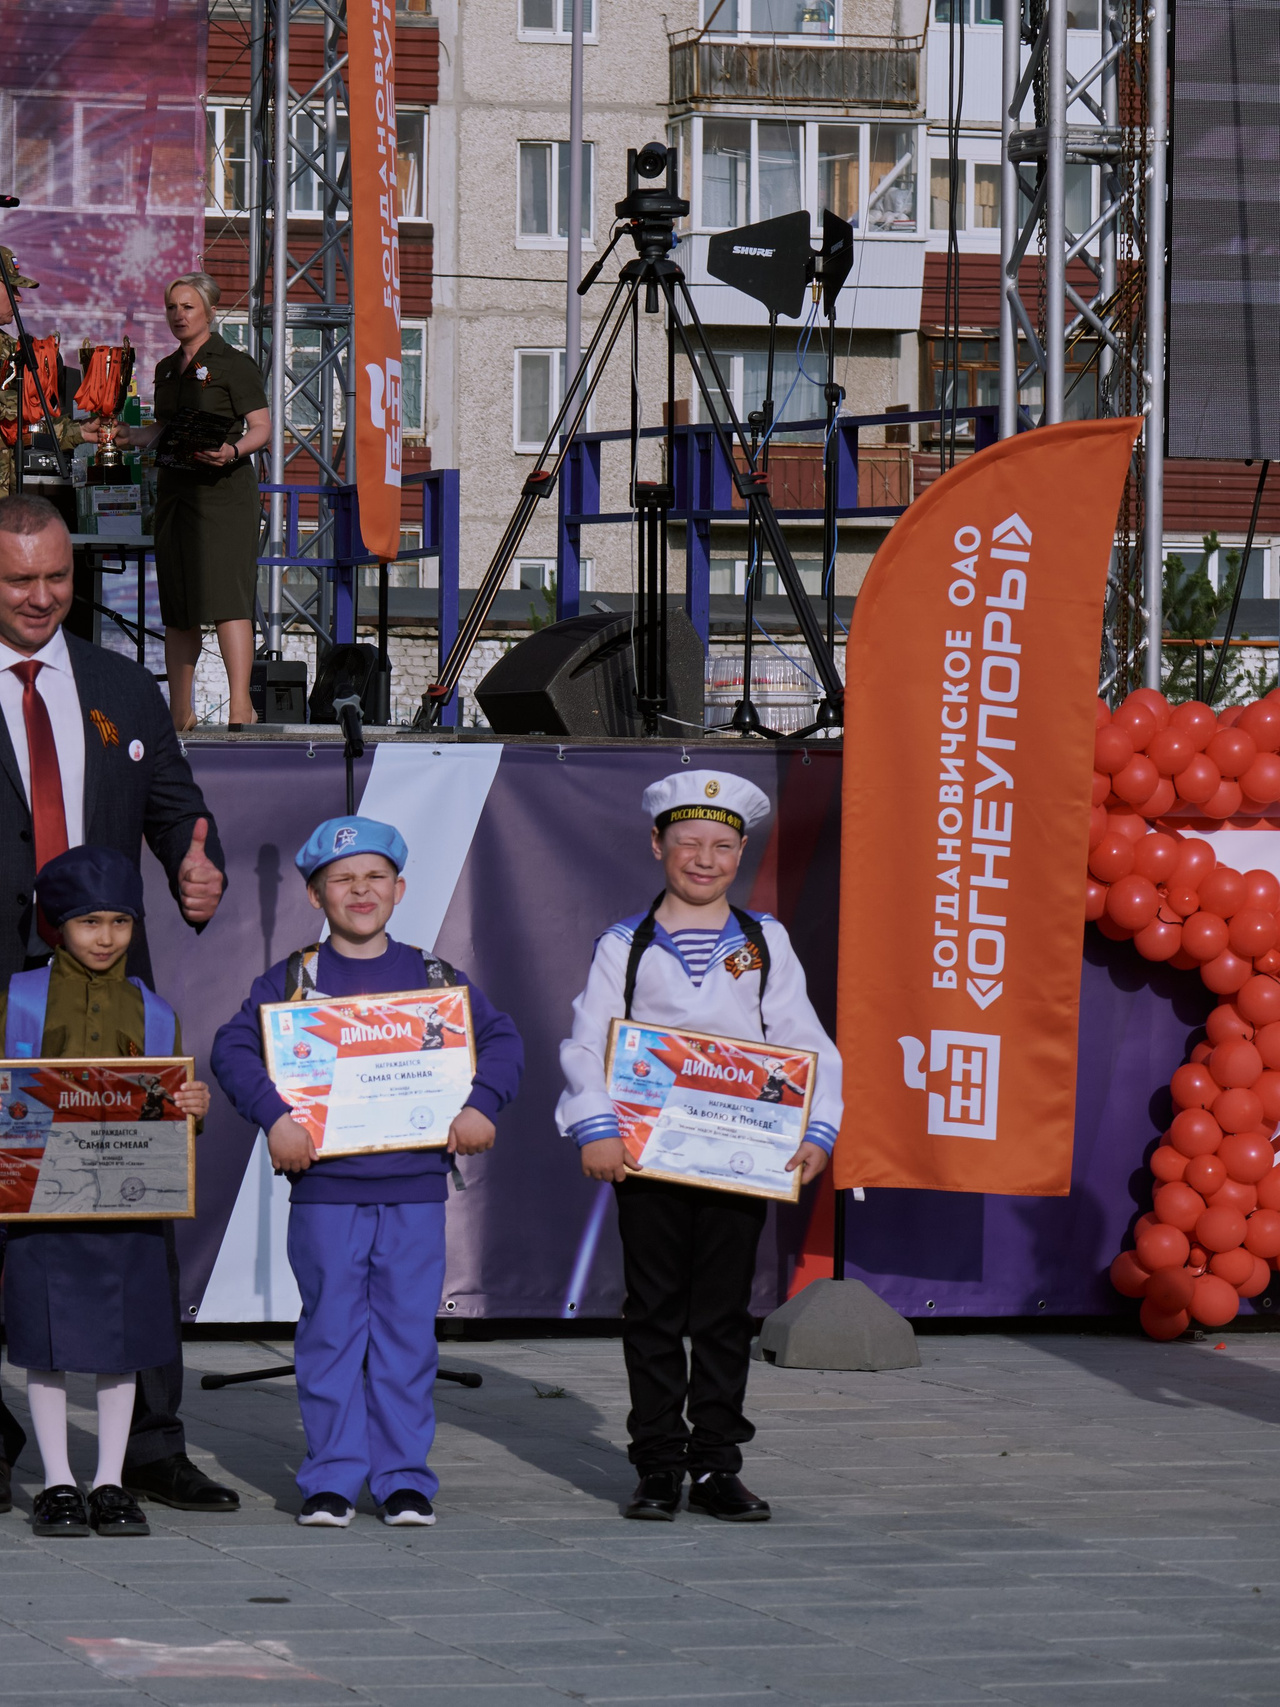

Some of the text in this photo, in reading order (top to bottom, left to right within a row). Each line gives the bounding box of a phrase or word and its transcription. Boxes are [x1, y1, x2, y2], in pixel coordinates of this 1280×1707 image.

[732, 245, 775, 258] SHURE
[933, 525, 982, 990] БОГДАНОВИЧСКОЕ ОАО
[670, 806, 727, 823] РОССИЙСКИЙ
[340, 1021, 412, 1046] ДИПЛОМ
[375, 1059, 421, 1069] НАГРАЖДАЕТСЯ
[680, 1058, 755, 1085] ДИПЛОМ
[58, 1090, 132, 1109] ДИПЛОМ
[708, 1100, 755, 1113] НАГРАЖДАЕТСЯ
